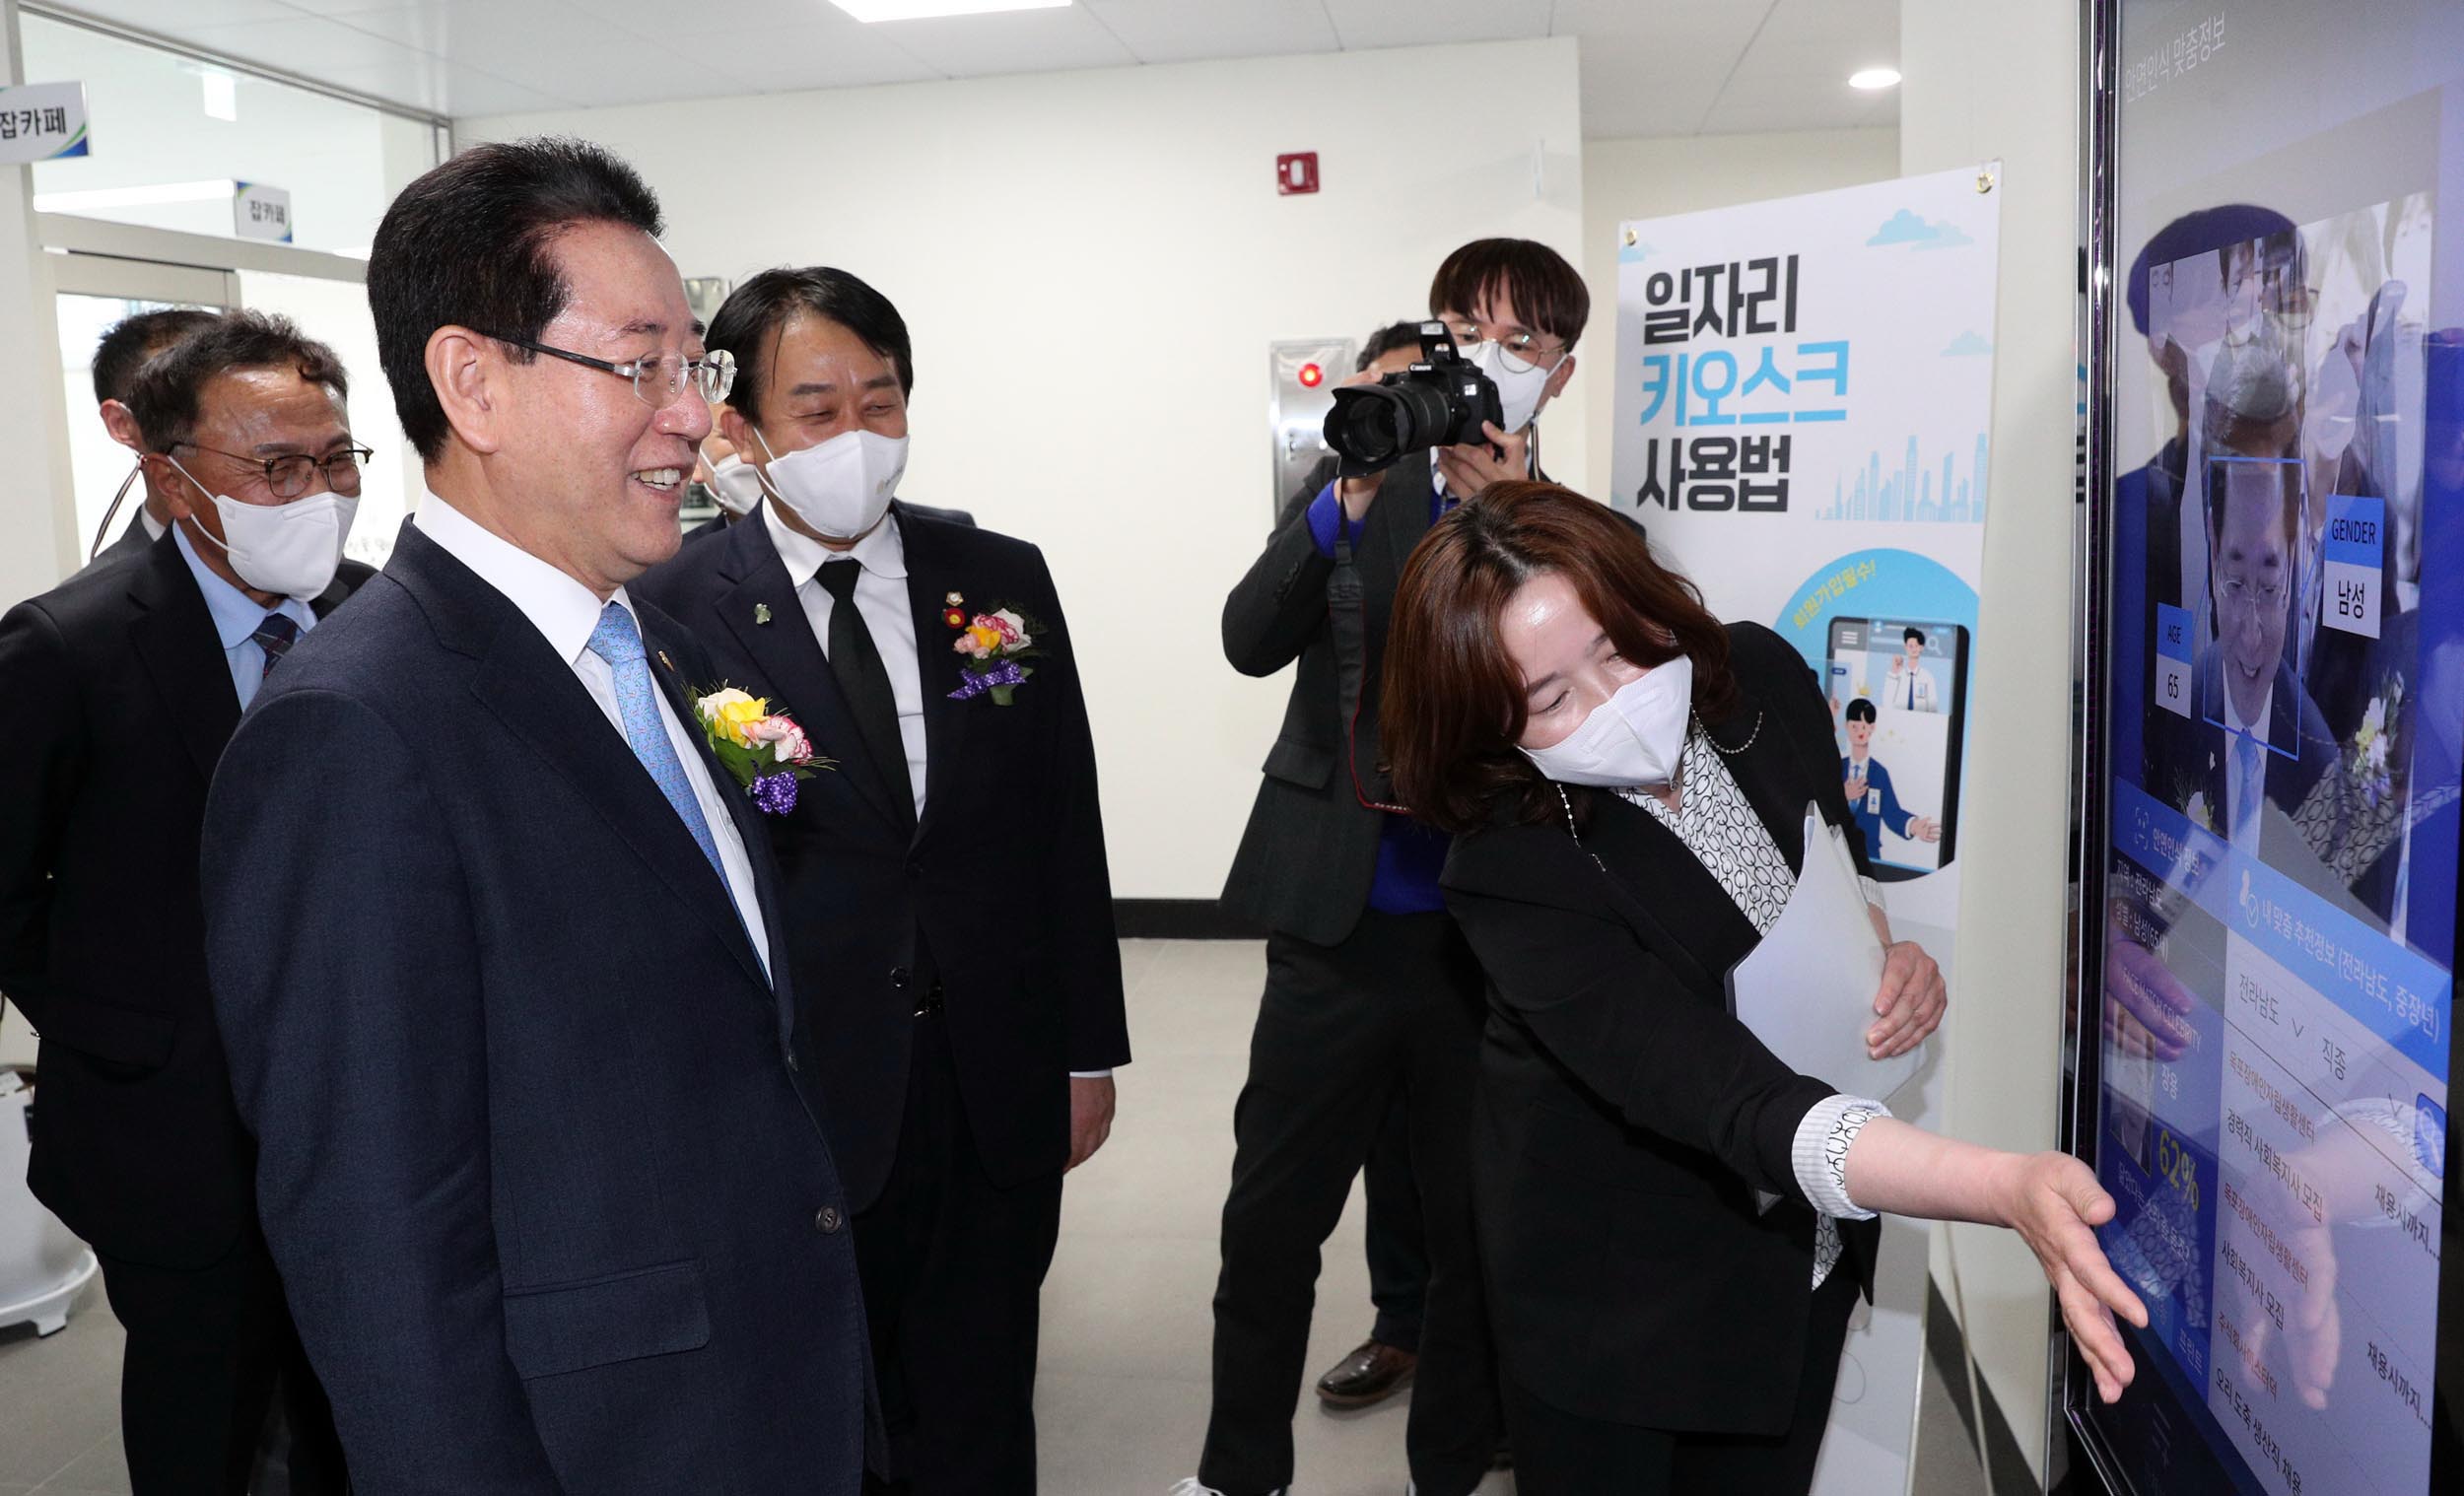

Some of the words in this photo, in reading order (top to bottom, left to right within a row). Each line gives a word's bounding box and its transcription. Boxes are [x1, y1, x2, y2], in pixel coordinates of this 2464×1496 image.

[2125, 42, 2169, 102] 안면인식
[2173, 11, 2225, 77] 맞춤정보
[0, 106, 67, 139] 잡카페
[249, 199, 286, 225] 잡카페
[1644, 253, 1800, 345] 일자리
[1640, 340, 1850, 426] 키오스크
[1636, 435, 1791, 511] 사용법
[2331, 518, 2376, 545] GENDER
[2338, 579, 2365, 619] 남성
[2167, 625, 2181, 645] AGE
[2167, 673, 2179, 699] 65
[2153, 828, 2182, 868] 안면인식
[2135, 872, 2162, 911] 전라남도
[2262, 900, 2272, 924] 내
[2273, 912, 2293, 939] 맞춤
[2294, 919, 2335, 967] 추천정보
[2239, 974, 2279, 1025] 전라남도
[2162, 1004, 2202, 1053] CELEBRITY
[2322, 1037, 2346, 1081] 직종
[2159, 1129, 2200, 1211] 62%
[2227, 1108, 2253, 1152] 경력직
[2254, 1135, 2300, 1199] 사회복지사
[2301, 1184, 2323, 1223] 모집
[2222, 1240, 2264, 1308] 사회복지사
[2265, 1291, 2285, 1331] 모집
[2178, 1327, 2203, 1376] 프린트
[2216, 1368, 2232, 1404] 오리
[2234, 1392, 2252, 1431] 도축
[2253, 1418, 2281, 1473] 생산직
[2282, 1458, 2303, 1496] 채용
